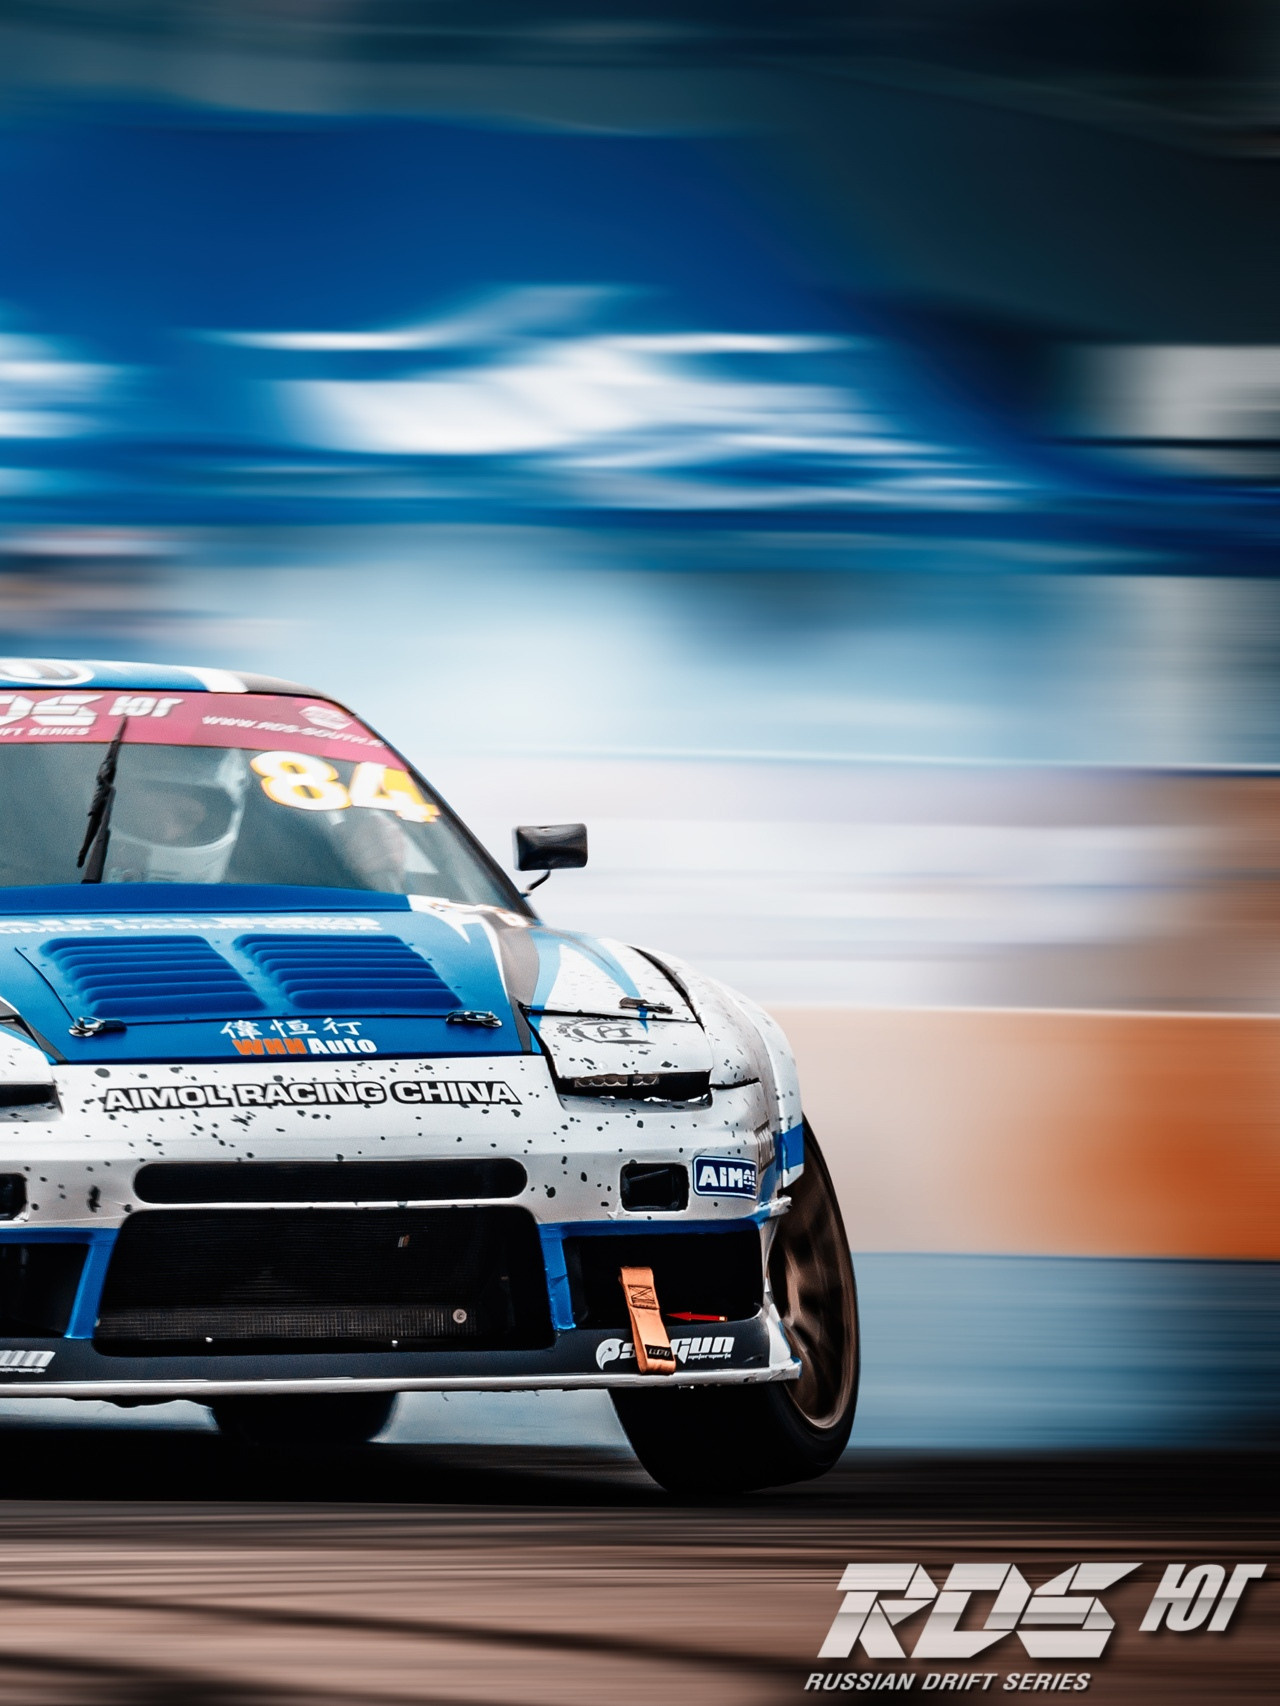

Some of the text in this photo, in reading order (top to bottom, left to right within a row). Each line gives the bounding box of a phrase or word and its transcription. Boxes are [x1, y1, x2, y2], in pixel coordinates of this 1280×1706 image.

[28, 726, 90, 737] SERIES
[201, 714, 387, 748] WWW.RDS-SOUTH.R
[250, 751, 441, 823] 84
[105, 1081, 521, 1112] AIMOL RACING CHINA
